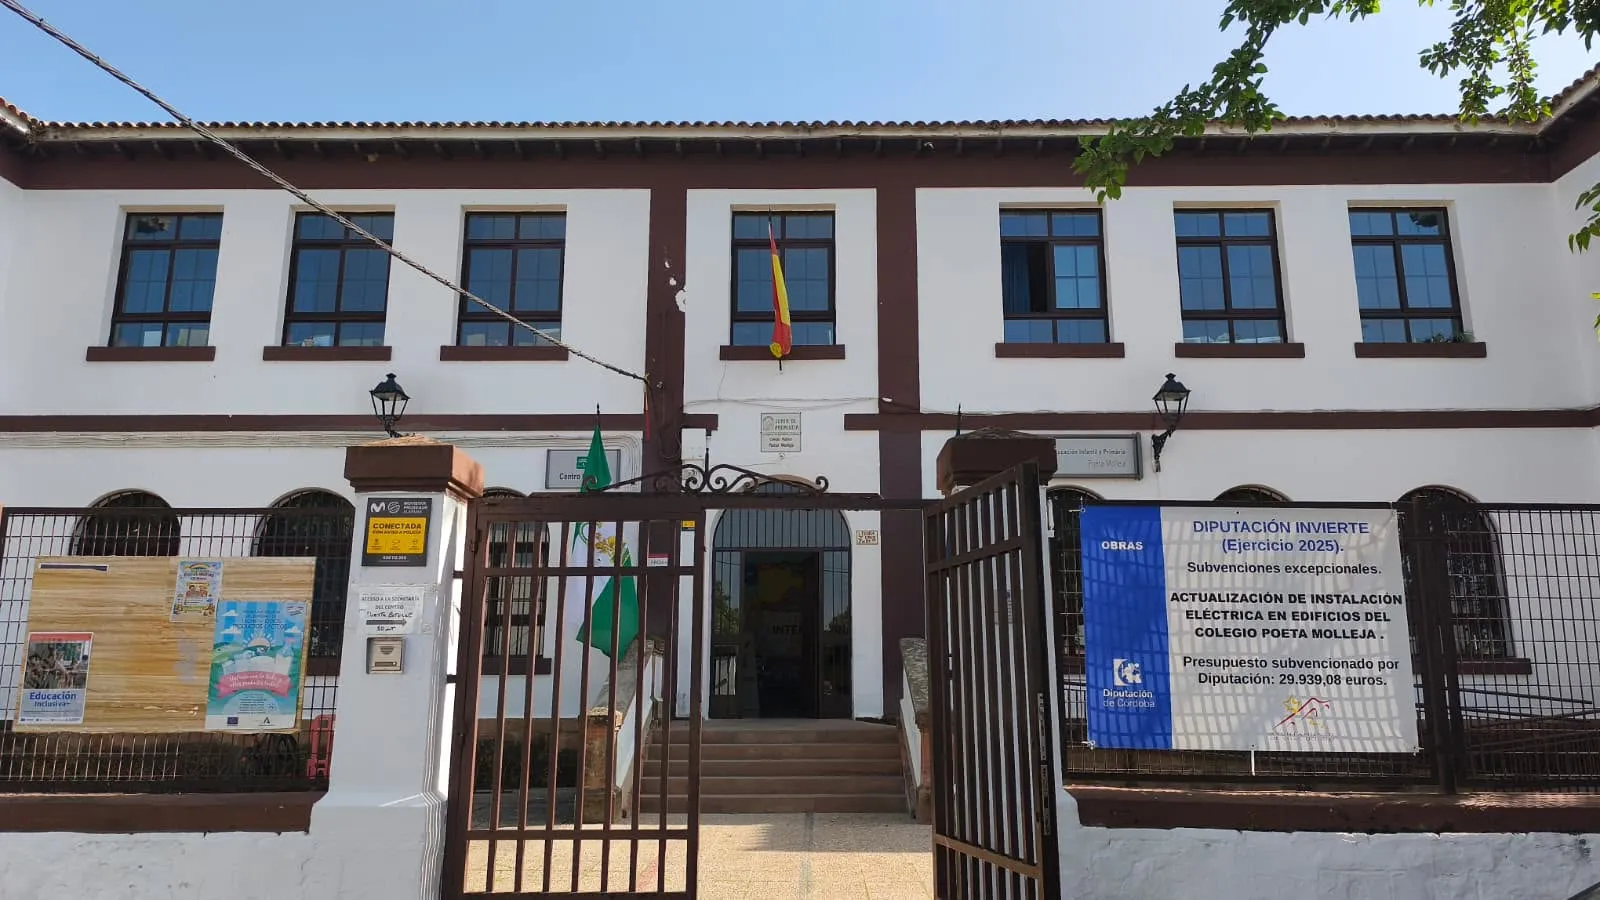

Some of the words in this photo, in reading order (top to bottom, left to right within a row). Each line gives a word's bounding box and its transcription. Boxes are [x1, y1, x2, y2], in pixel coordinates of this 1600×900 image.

[1193, 519, 1290, 534] DIPUTACIÓN
[1296, 522, 1369, 534] INVIERTE
[1102, 541, 1143, 550] OBRAS
[1222, 539, 1293, 554] (Ejercicio
[1298, 540, 1344, 554] 2025).
[1187, 562, 1280, 573] Subvenciones
[1285, 563, 1382, 576] excepcionales.
[1170, 592, 1283, 604] ACTUALIZACIÓN
[1288, 594, 1306, 604] DE
[1311, 592, 1402, 604] INSTALACIÓN
[1186, 608, 1264, 620] ELÉCTRICA
[1268, 611, 1287, 620] EN
[1292, 611, 1360, 621] EDIFICIOS
[1365, 612, 1391, 622] DEL
[1195, 628, 1257, 638] COLEGIO
[1262, 628, 1307, 638] POETA
[1312, 629, 1376, 639] MOLLEJA
[1183, 656, 1267, 670] Presupuesto
[1272, 657, 1373, 669] subvencionado
[1378, 660, 1399, 672] por
[1198, 673, 1274, 686] Diputación:
[1279, 674, 1341, 687] 29.939,08
[1345, 676, 1387, 686] euros.
[30, 691, 76, 700] Educación
[1103, 688, 1153, 699] Diputación
[1104, 699, 1114, 707] de
